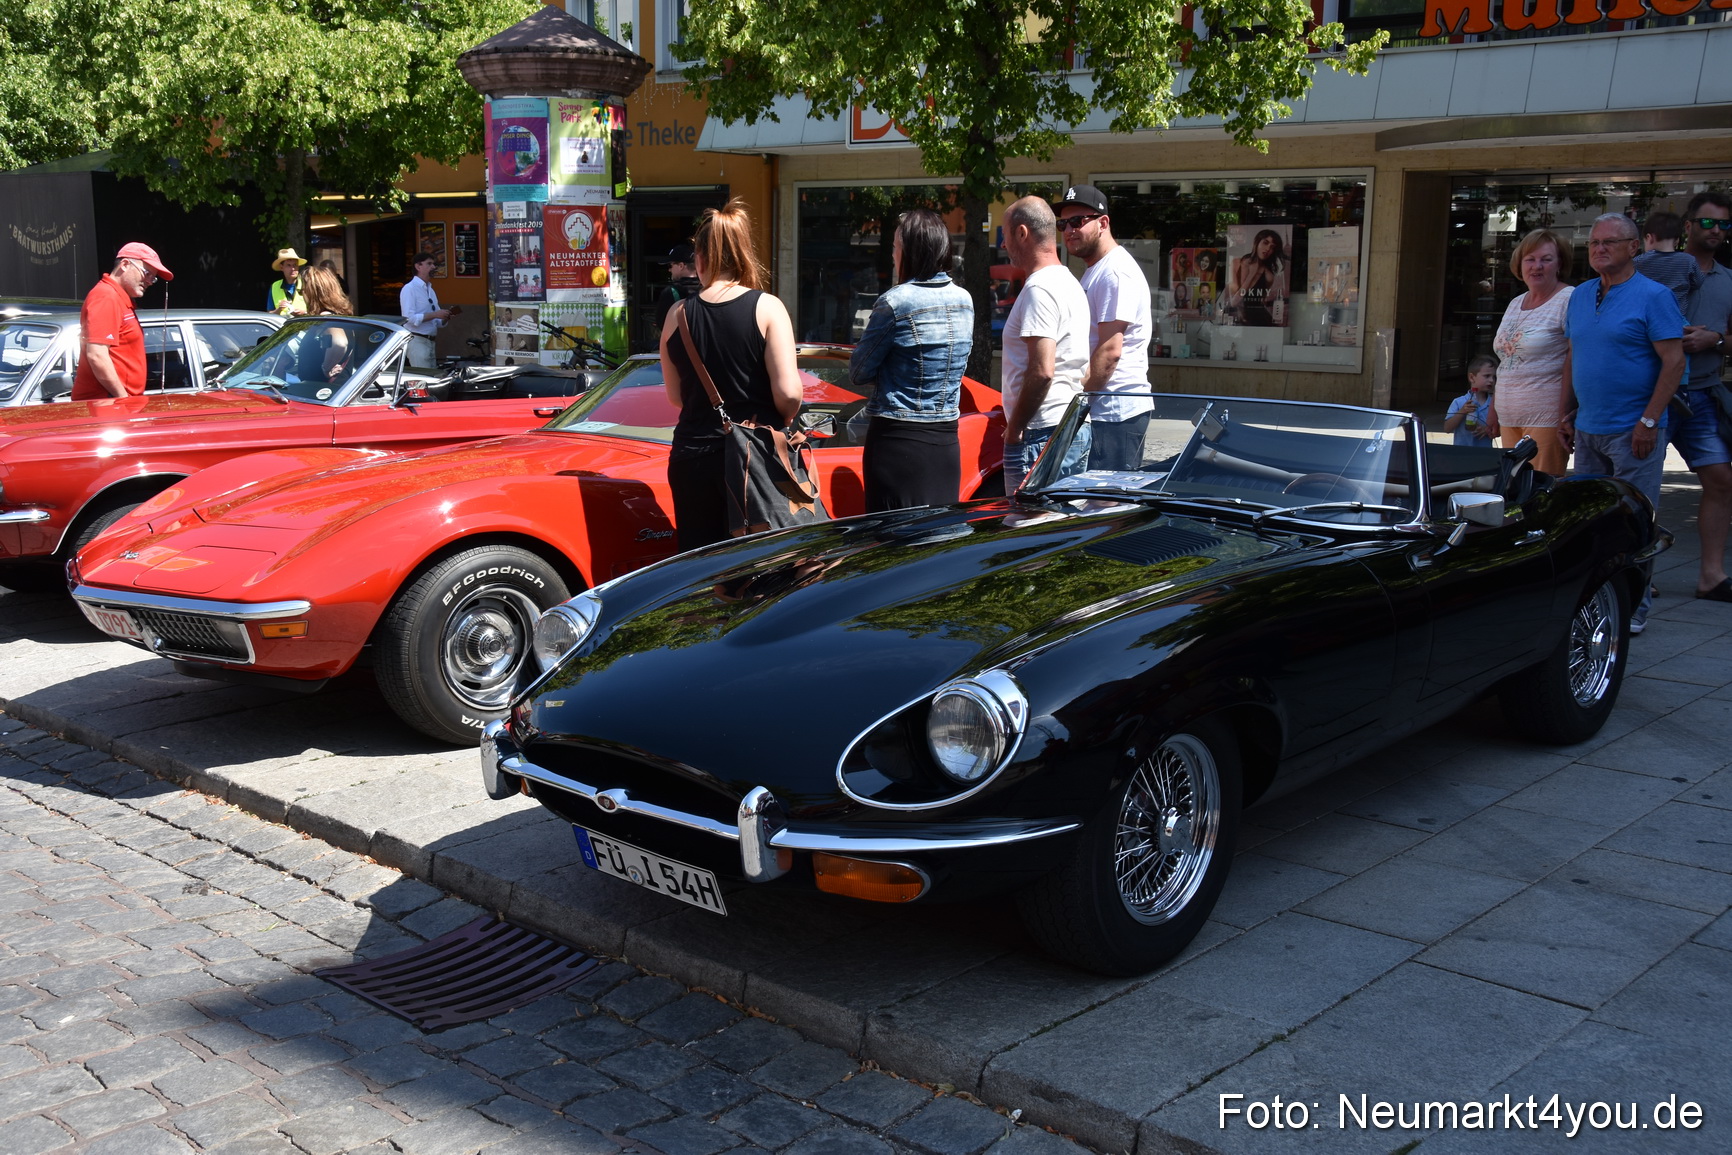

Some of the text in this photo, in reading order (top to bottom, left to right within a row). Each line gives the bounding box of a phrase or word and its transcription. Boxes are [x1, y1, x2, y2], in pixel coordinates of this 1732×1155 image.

[561, 112, 582, 123] Park
[636, 120, 696, 146] Theke
[549, 252, 607, 260] NEUMARKTER
[1240, 288, 1271, 297] DKNY
[442, 565, 545, 606] BFGoodrich
[585, 851, 592, 860] D
[590, 836, 628, 877] FÜ
[658, 862, 721, 909] 54H
